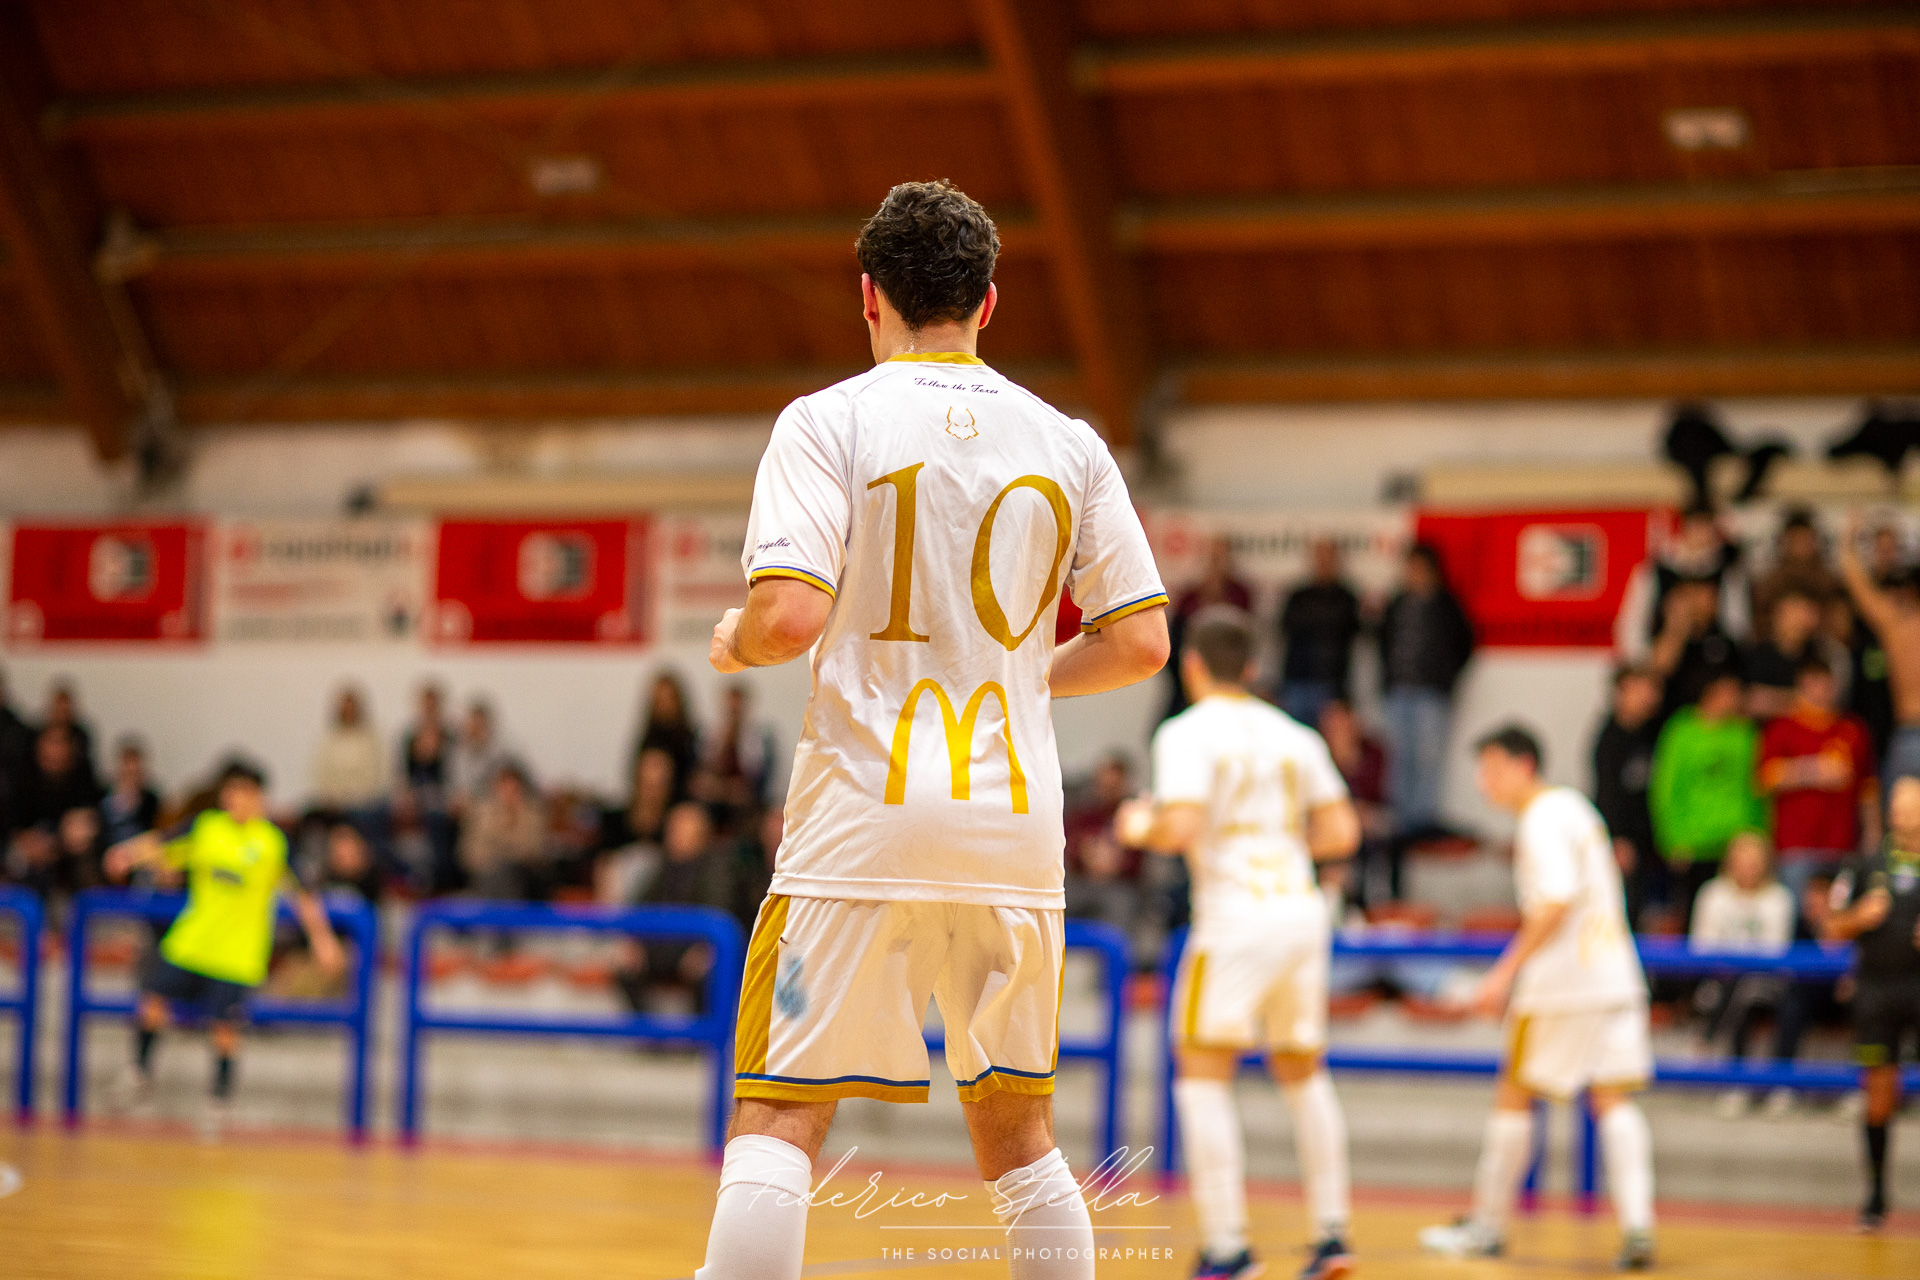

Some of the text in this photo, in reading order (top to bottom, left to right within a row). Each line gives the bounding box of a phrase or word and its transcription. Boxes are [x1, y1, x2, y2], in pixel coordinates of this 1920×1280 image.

[914, 377, 999, 394] Follow the Foxes
[757, 536, 791, 554] nigallia
[866, 461, 1072, 652] 10
